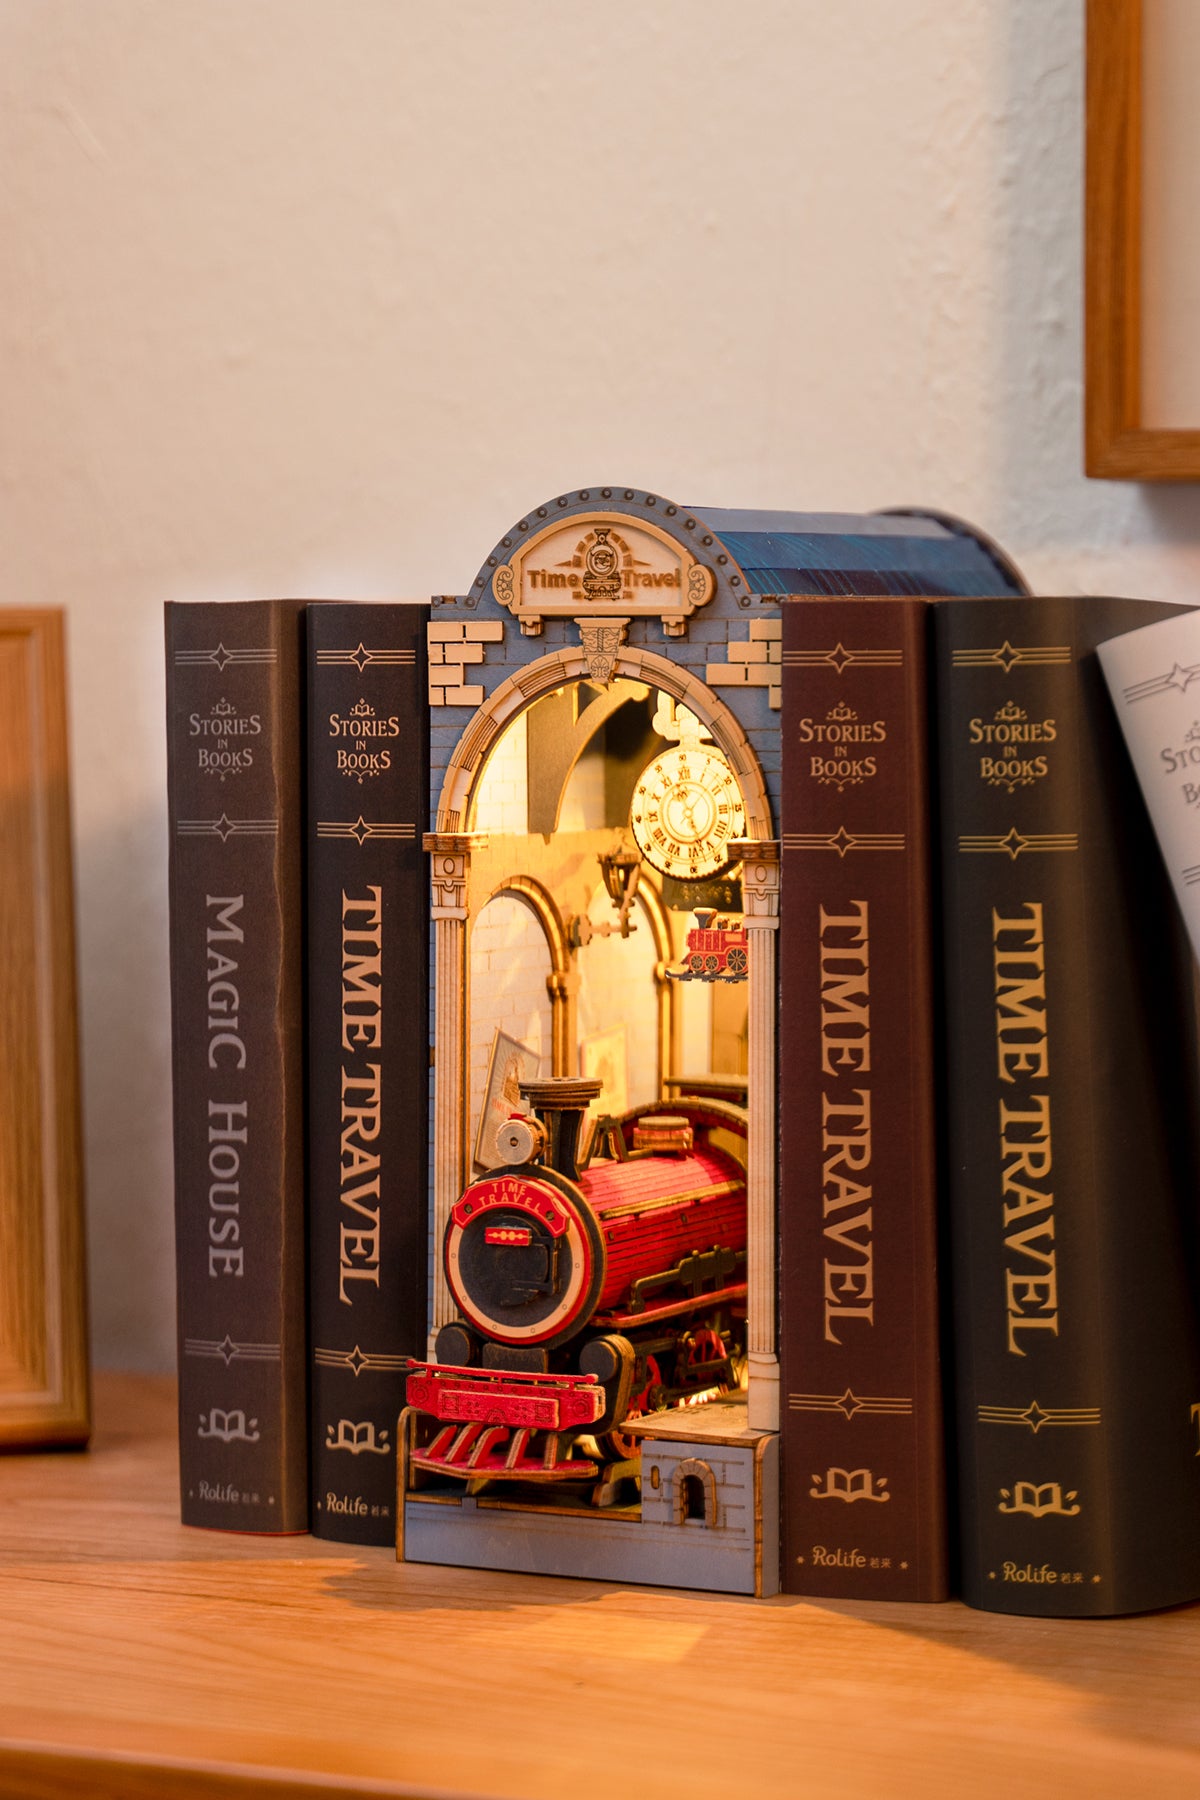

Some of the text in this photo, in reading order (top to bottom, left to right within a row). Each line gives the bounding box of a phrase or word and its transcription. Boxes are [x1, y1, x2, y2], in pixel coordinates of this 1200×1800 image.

[526, 567, 682, 589] Time Travel
[189, 713, 262, 736] STORIES
[329, 713, 400, 737] STORIES
[799, 718, 887, 743] STORIES
[969, 718, 1057, 744] STORIES
[217, 738, 228, 749] IN
[355, 740, 366, 751] IN
[834, 745, 848, 758] IN
[1003, 746, 1018, 758] IN
[198, 749, 254, 767] BOOKS
[337, 750, 391, 769] BOOKS
[810, 757, 877, 777] BOOKS
[980, 757, 1049, 778] BOOKS
[206, 894, 248, 1278] MAGIC HOUSE
[339, 884, 383, 1306] TIME TRAVEL
[819, 899, 874, 1346] TIME TRAVEL
[992, 902, 1059, 1357] TIME TRAVEL
[491, 1182, 527, 1196] TIME
[478, 1193, 541, 1212] TRAVEL
[199, 1480, 240, 1503] Rolife
[326, 1492, 368, 1516] Rolife
[812, 1545, 867, 1569] Rolife
[1002, 1560, 1058, 1585] Rolife
